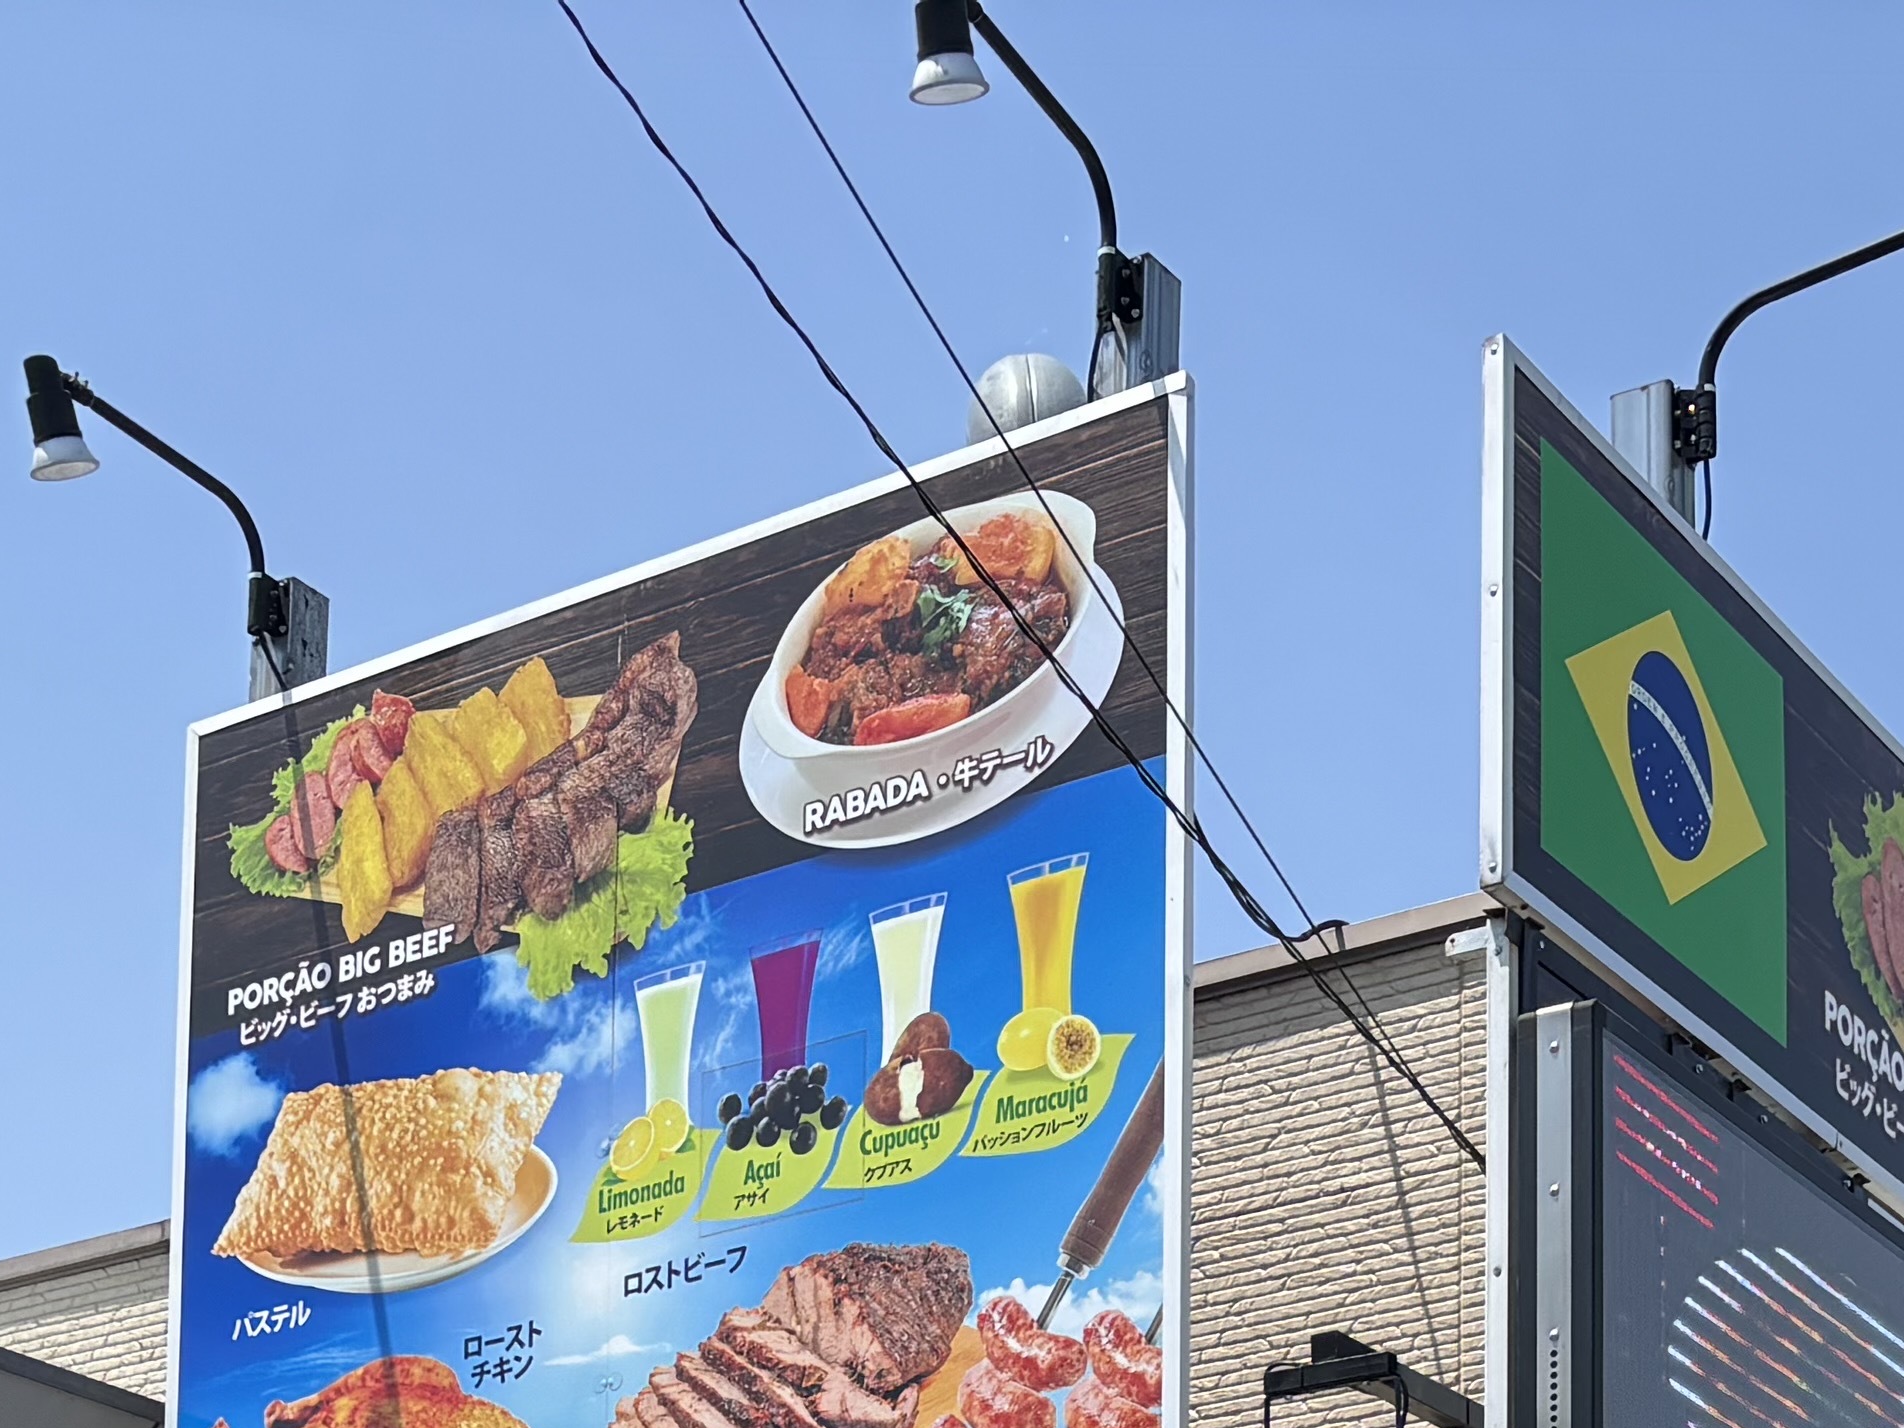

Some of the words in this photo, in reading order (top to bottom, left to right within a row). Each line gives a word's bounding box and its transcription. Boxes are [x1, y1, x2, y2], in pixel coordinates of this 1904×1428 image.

[804, 770, 929, 832] RABADA
[227, 961, 332, 1016] PORÇÃO
[338, 946, 382, 983] BIG
[388, 924, 455, 968] BEEF
[239, 993, 353, 1046] ビッグ・ビーフ
[356, 970, 435, 1014] おつまみ
[995, 1083, 1089, 1124] Maracujá
[860, 1120, 940, 1158] Cupuaçu
[970, 1111, 1090, 1153] パッションフルーツ
[743, 1153, 782, 1189] Açaí
[597, 1170, 686, 1214] Limonada
[733, 1187, 769, 1211] アサイ
[606, 1205, 664, 1235] レモネード
[623, 1245, 749, 1297] ロストビーフ
[231, 1300, 312, 1341] パステル
[463, 1320, 543, 1361] ロースト
[470, 1355, 534, 1389] チキン
